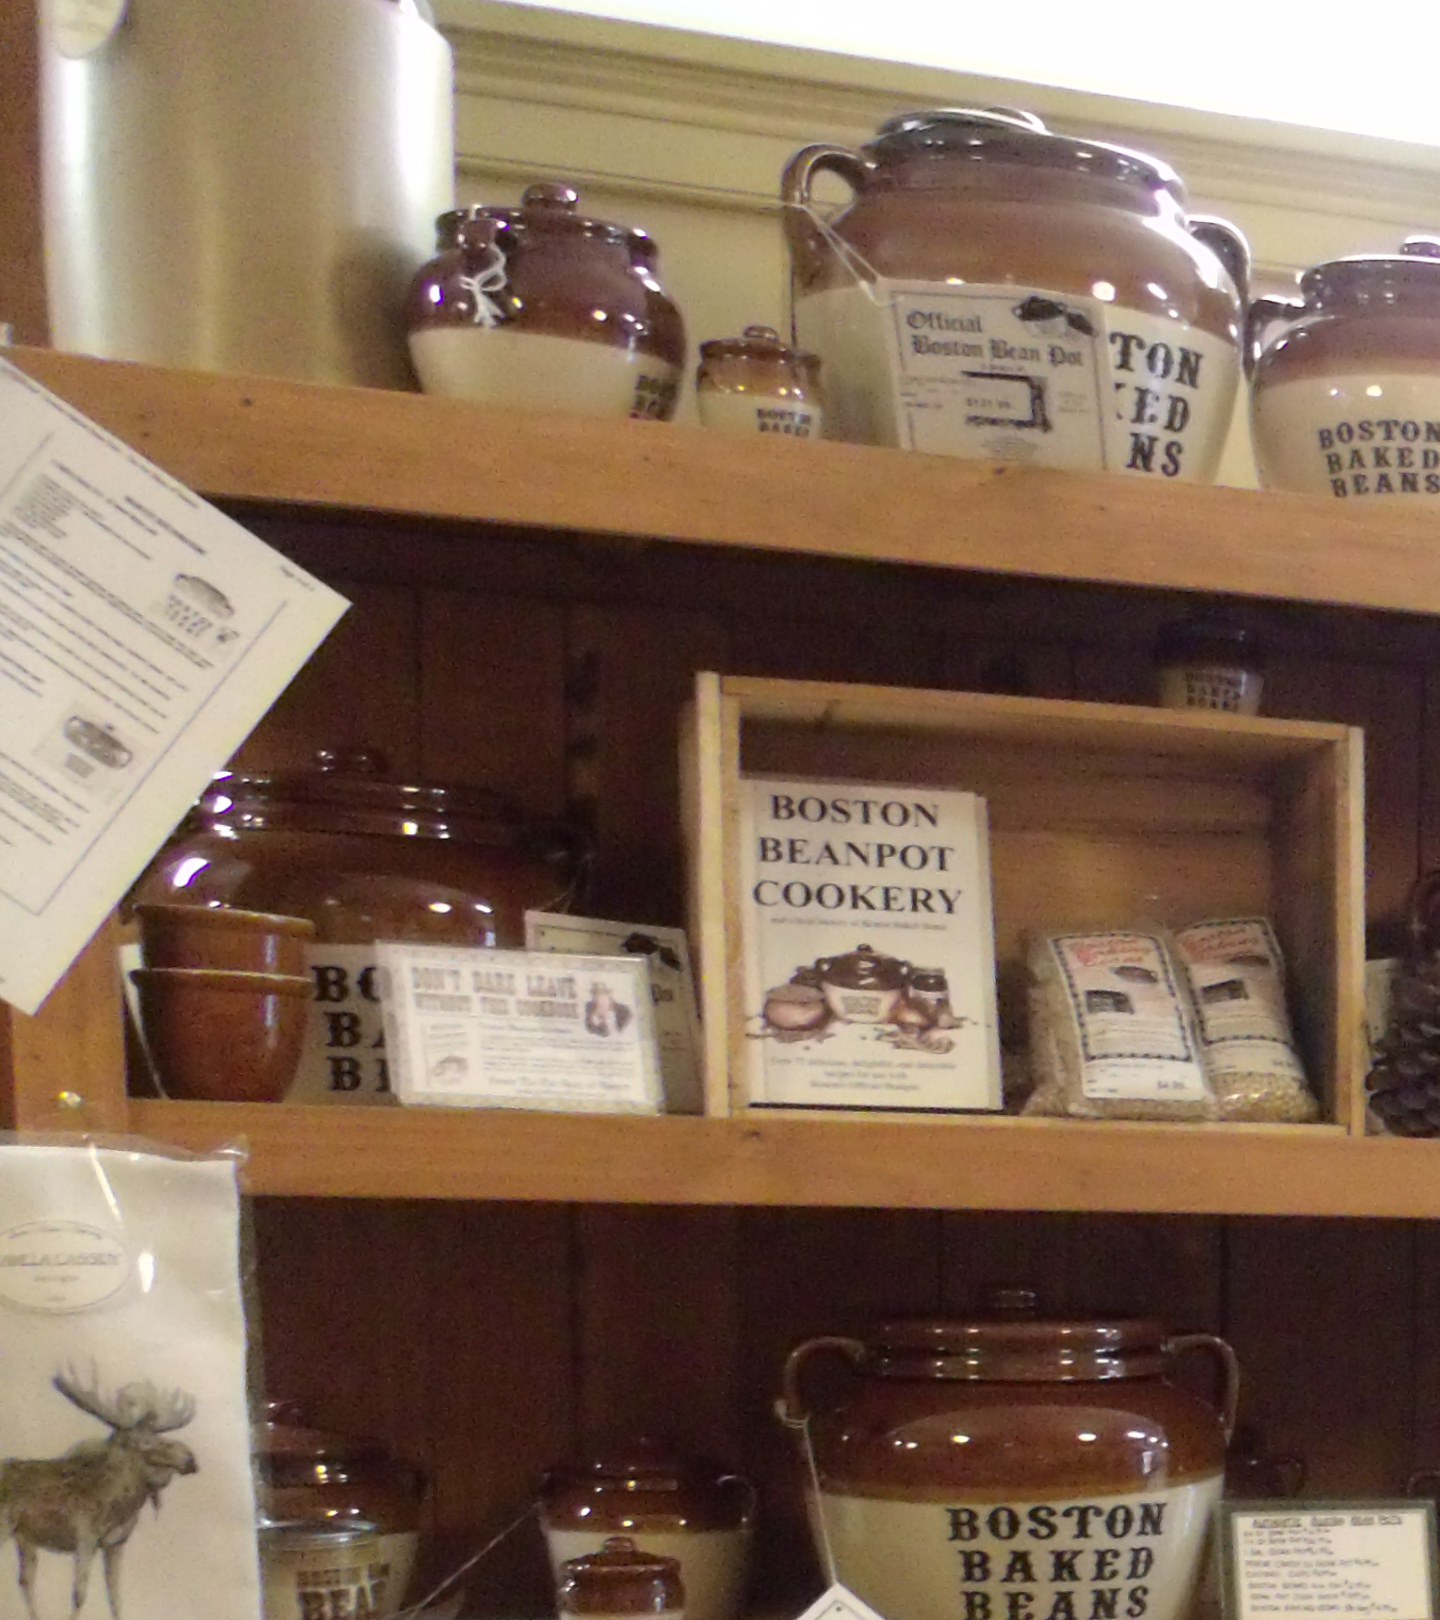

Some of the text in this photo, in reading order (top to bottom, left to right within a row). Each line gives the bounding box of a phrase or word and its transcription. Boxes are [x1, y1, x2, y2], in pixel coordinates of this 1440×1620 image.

[907, 310, 983, 335] Official
[911, 334, 1084, 367] Boston Bean Pot
[1109, 332, 1204, 389] TON
[771, 795, 938, 828] BOSTON
[759, 836, 955, 871] BEANPOT
[753, 879, 962, 915] COOKERY
[945, 1502, 1167, 1542] BOSTON
[958, 1547, 1154, 1583] BAKED
